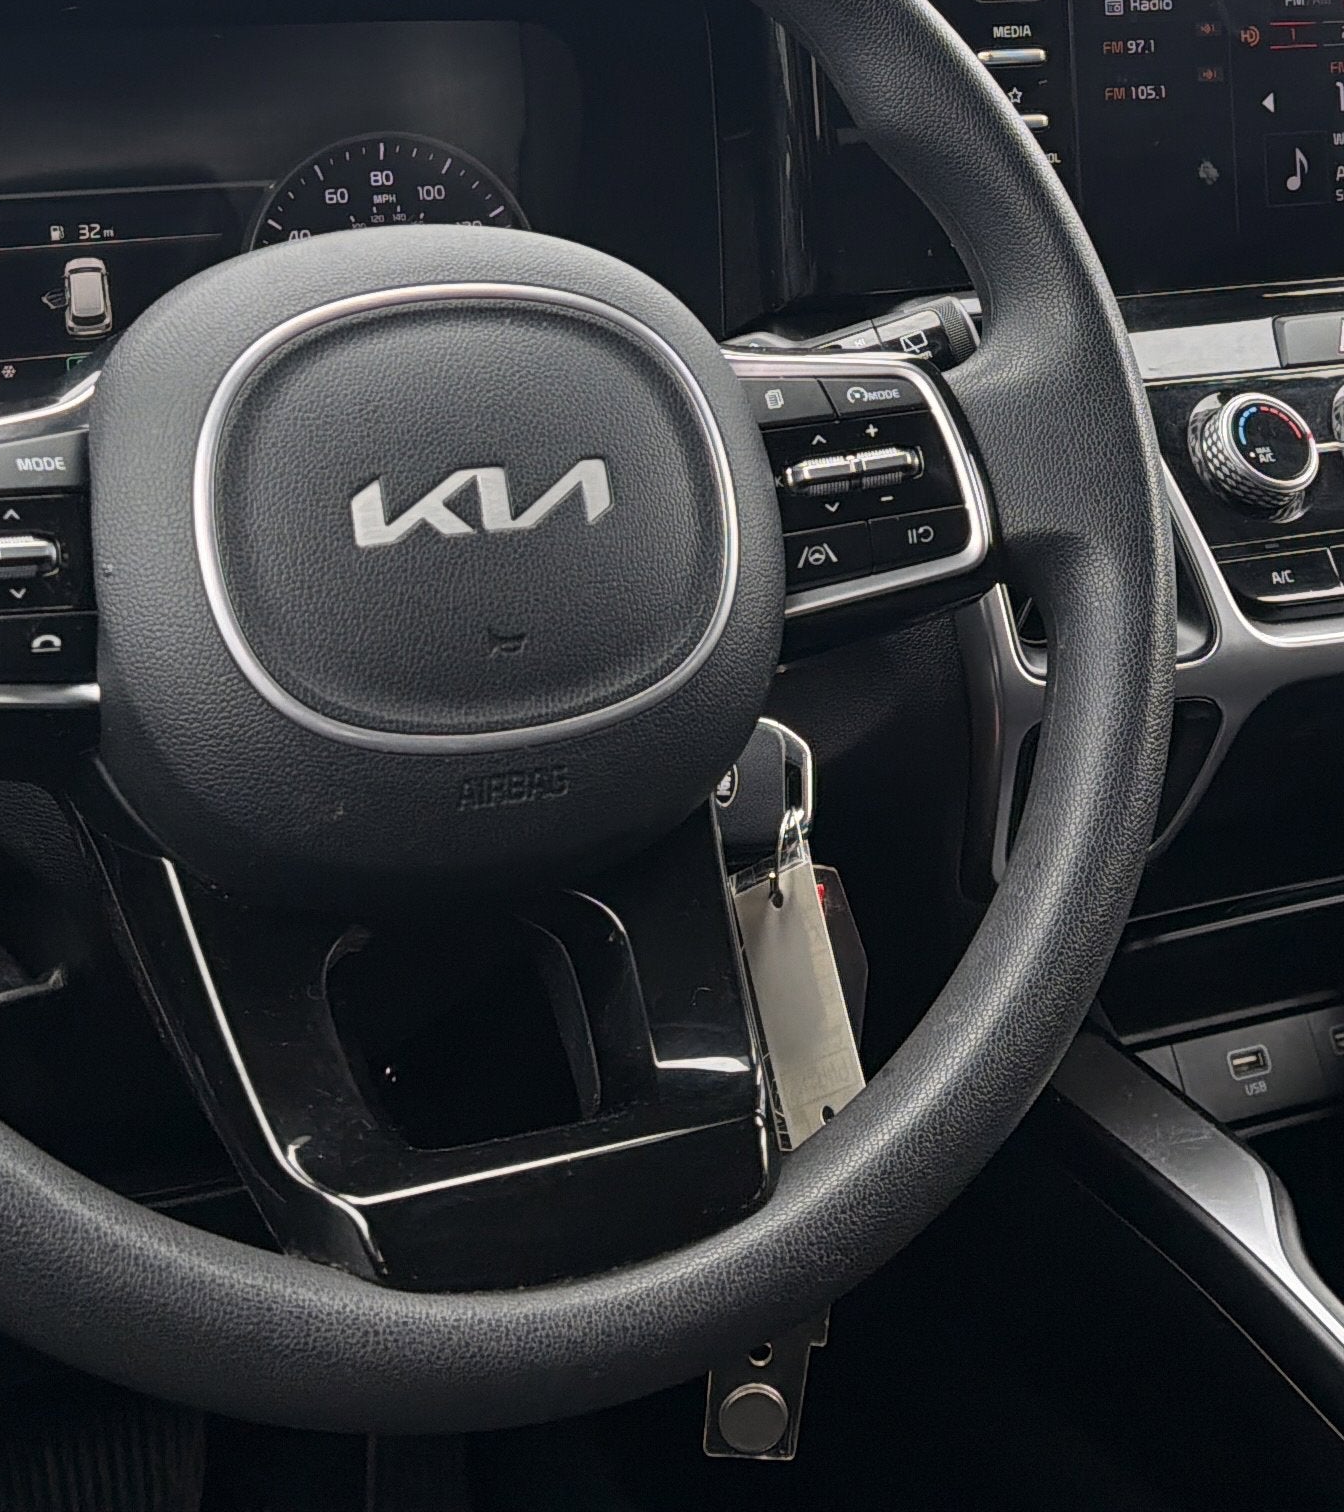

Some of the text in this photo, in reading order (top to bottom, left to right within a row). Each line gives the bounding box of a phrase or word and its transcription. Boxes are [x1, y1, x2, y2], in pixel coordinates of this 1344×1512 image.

[993, 24, 1032, 39] MEDIA
[1103, 39, 1155, 54] FM 97.1
[1105, 85, 1166, 100] FM 105.1
[369, 170, 394, 186] 80
[324, 188, 349, 204] 60
[372, 193, 397, 204] MPH
[417, 184, 446, 201] 100
[78, 223, 101, 240] 32
[868, 388, 901, 400] MODE
[16, 456, 67, 472] MODE
[350, 457, 614, 548] KIA
[1271, 569, 1296, 585] A/C
[1244, 1080, 1268, 1096] USB
